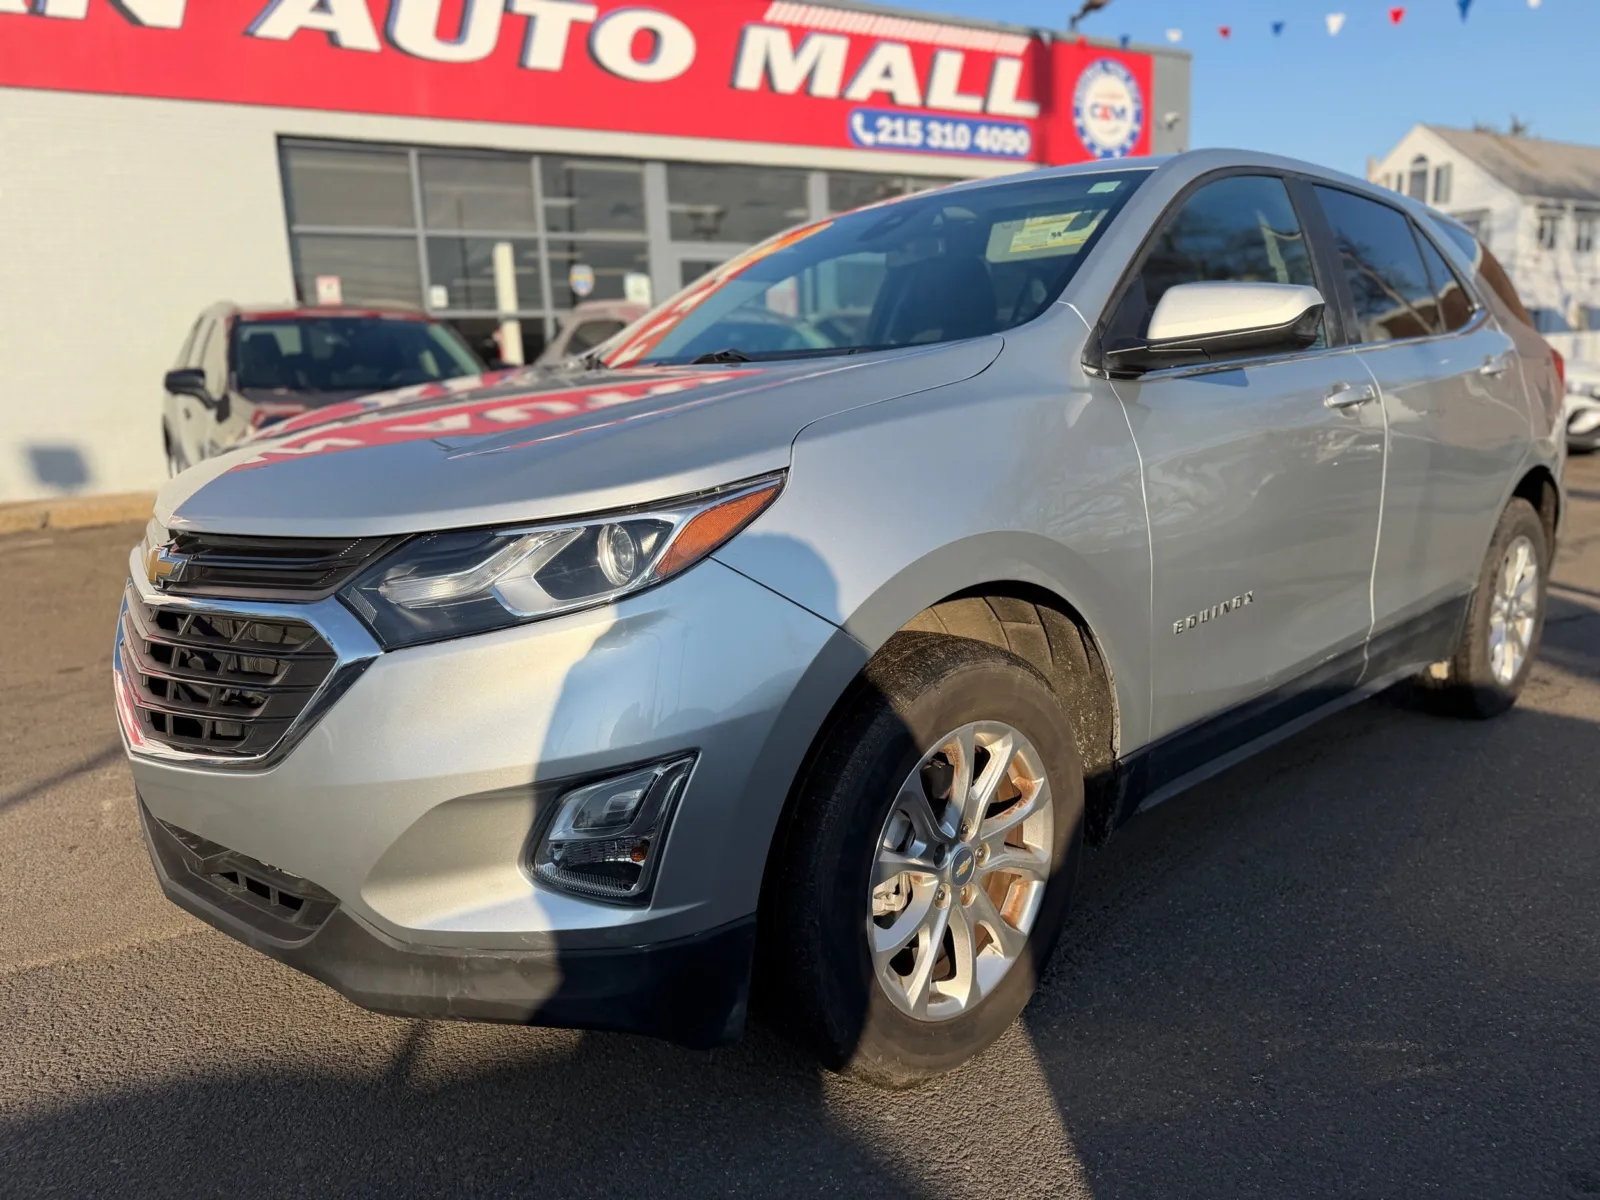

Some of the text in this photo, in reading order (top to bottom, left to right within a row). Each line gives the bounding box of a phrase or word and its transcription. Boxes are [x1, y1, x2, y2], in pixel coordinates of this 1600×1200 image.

[243, 0, 697, 82] AUTO
[731, 24, 1040, 118] MALL
[875, 116, 1032, 155] 215 310 4090
[1173, 590, 1254, 635] EQUINOX
